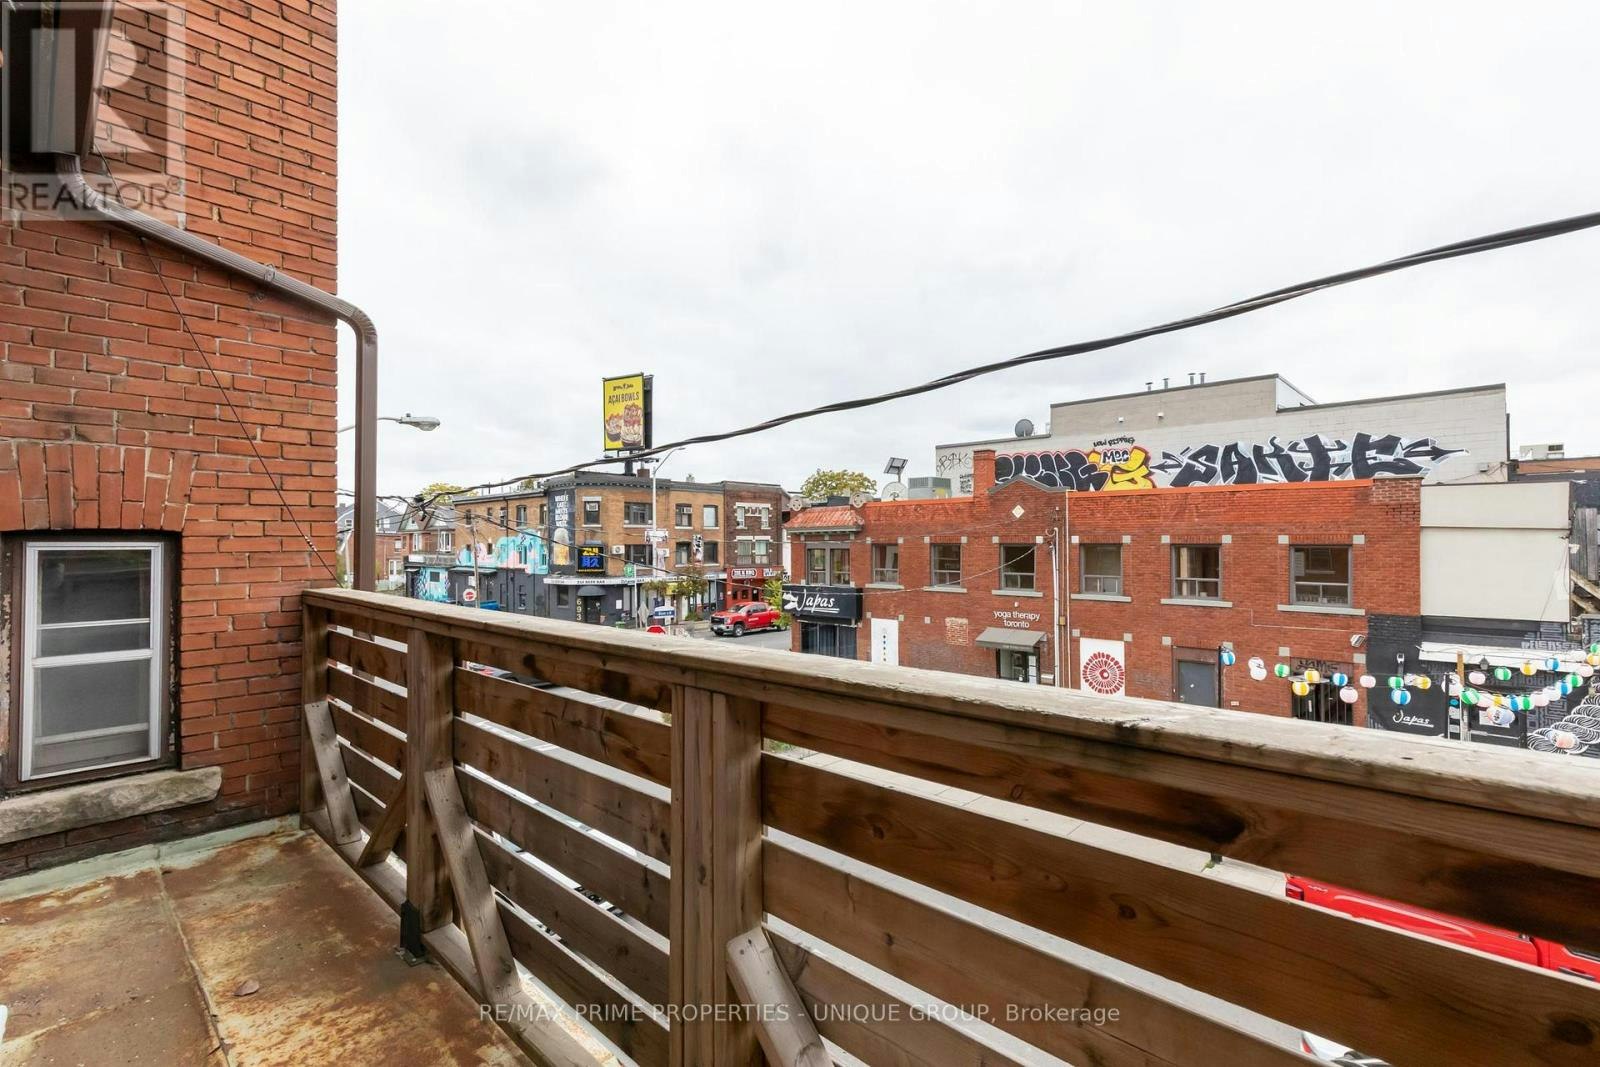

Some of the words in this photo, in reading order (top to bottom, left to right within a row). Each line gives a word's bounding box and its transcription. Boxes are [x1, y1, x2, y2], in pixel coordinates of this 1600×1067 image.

[621, 391, 640, 403] BOWLS
[795, 589, 836, 613] Japas
[993, 610, 1011, 620] yoga
[1012, 610, 1040, 621] therapy
[1003, 619, 1029, 628] toronto
[1392, 710, 1430, 725] Japas
